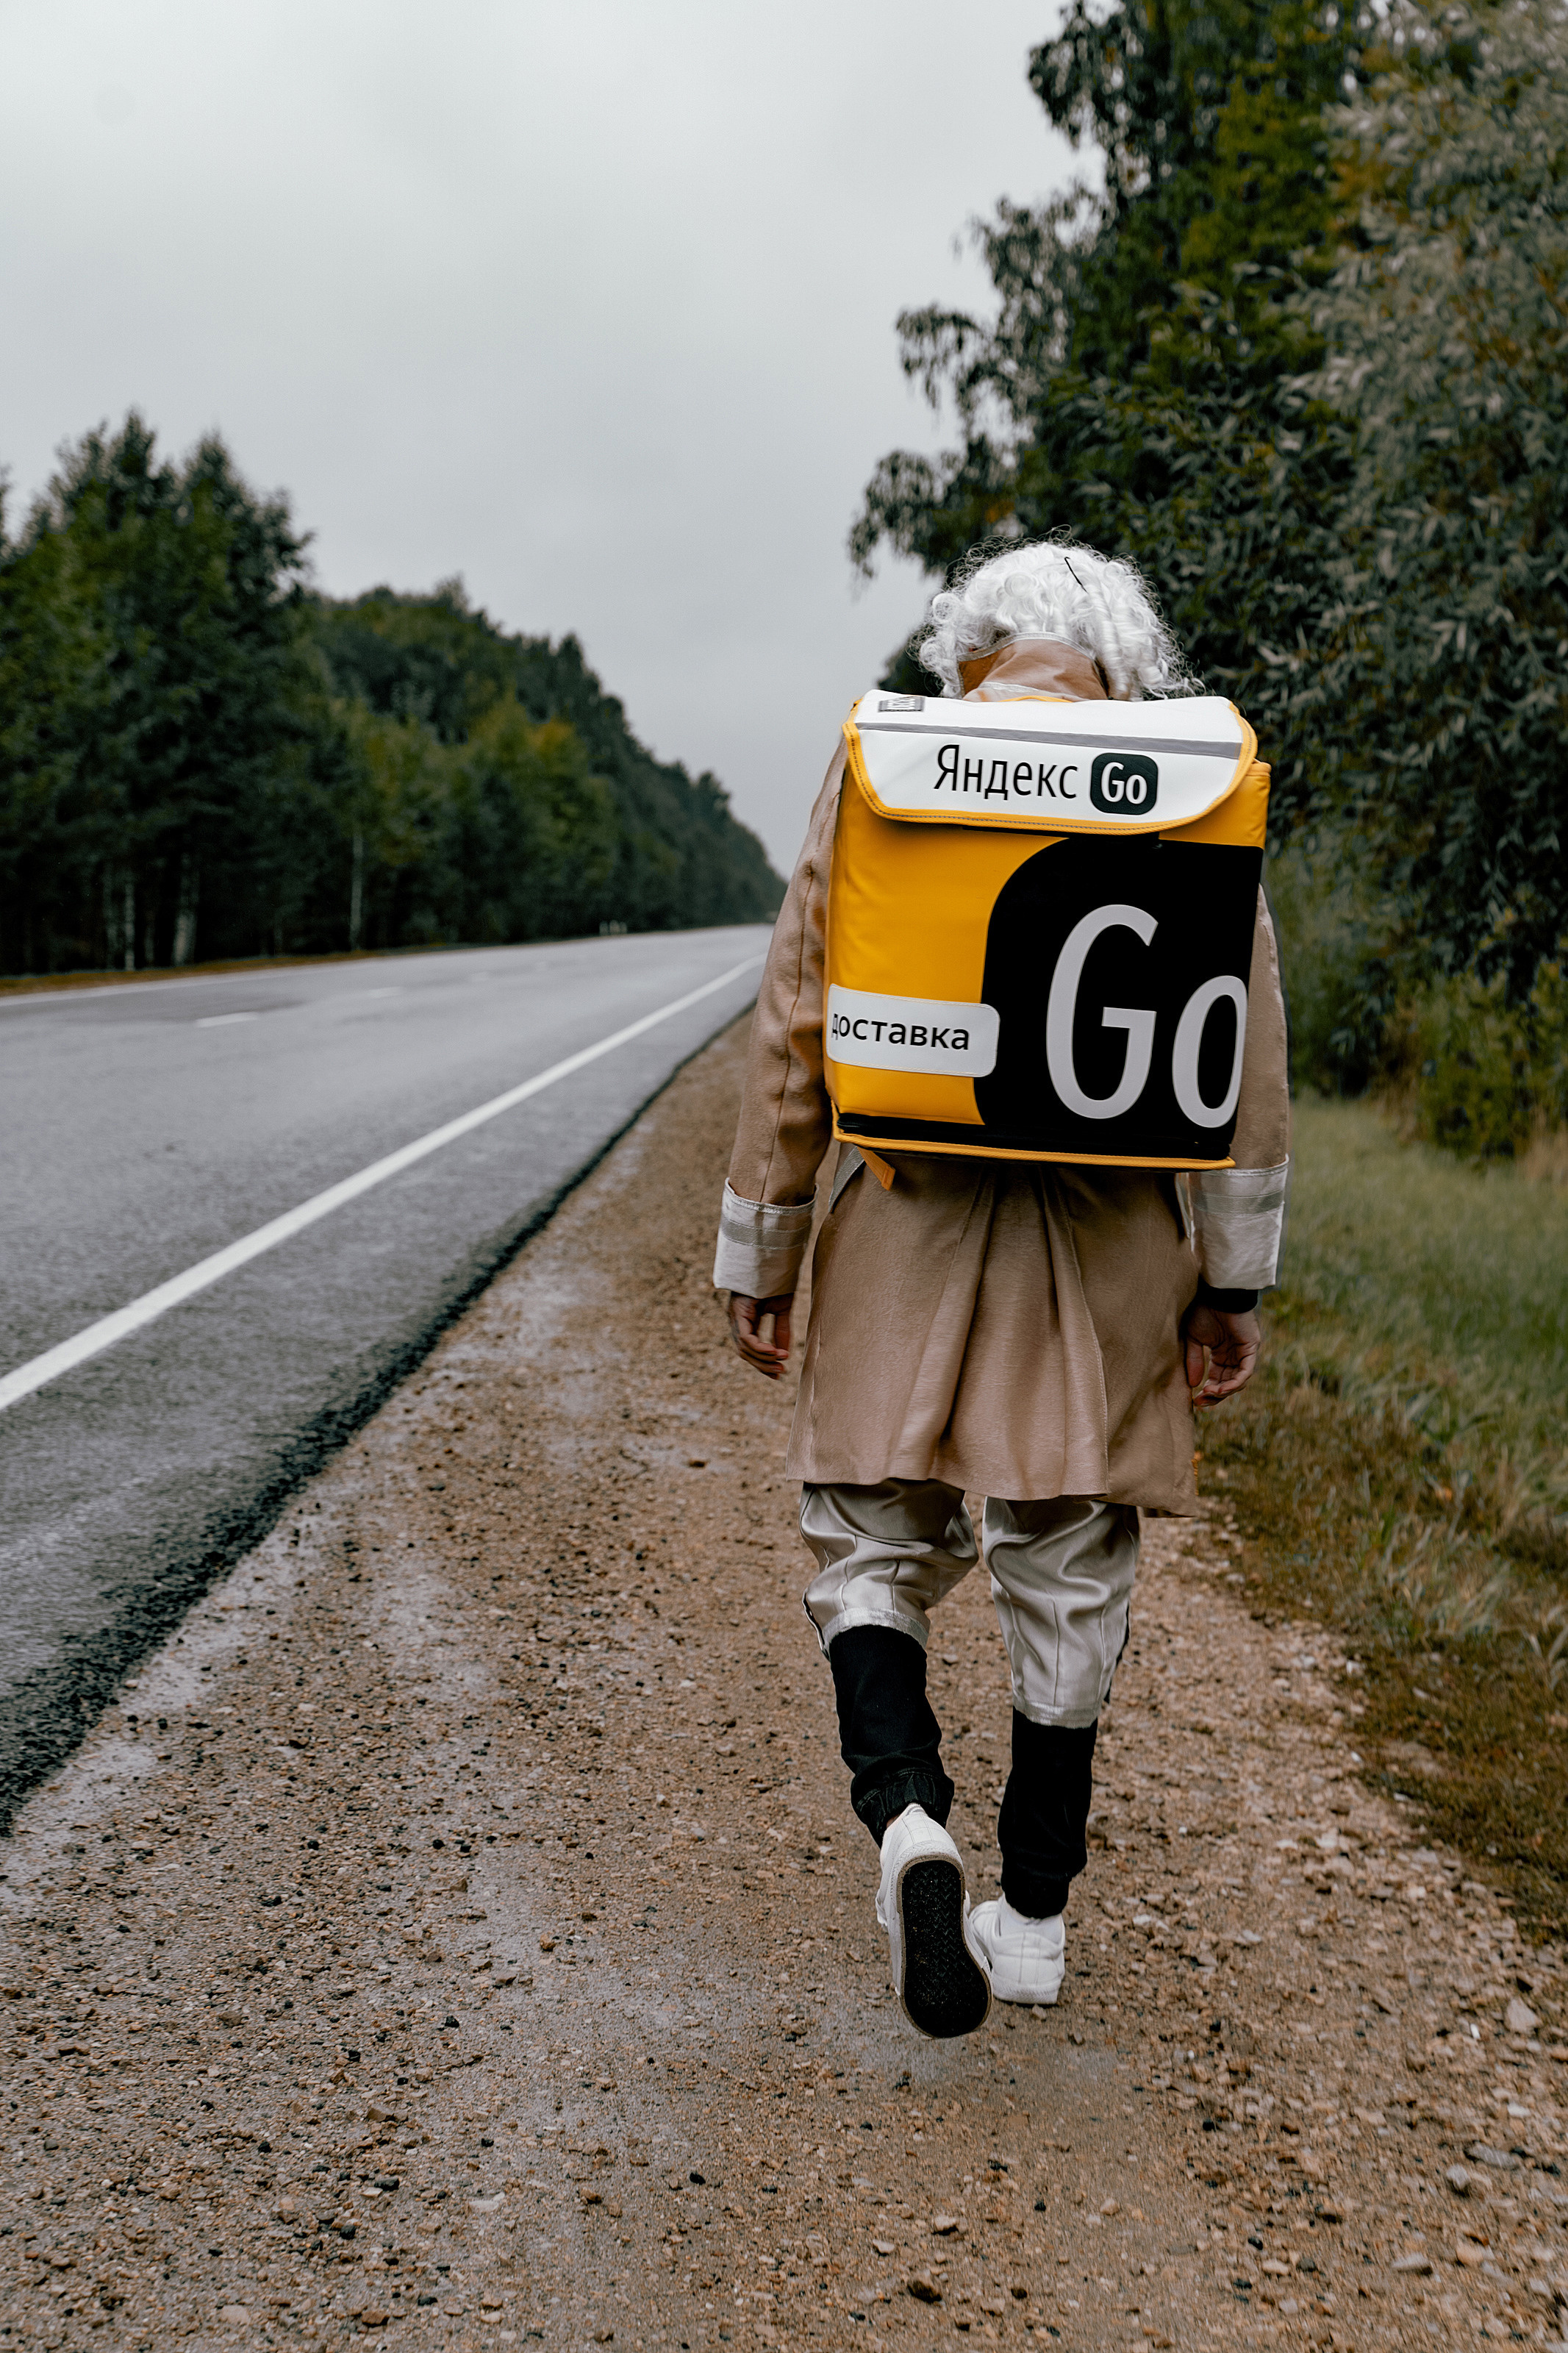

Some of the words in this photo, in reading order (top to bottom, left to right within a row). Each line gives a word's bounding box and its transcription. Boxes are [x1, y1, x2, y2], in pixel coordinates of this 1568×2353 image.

[934, 744, 1078, 801] Яндекс
[1100, 761, 1148, 805] Go
[831, 1013, 970, 1051] доставка
[1045, 904, 1248, 1128] Go
